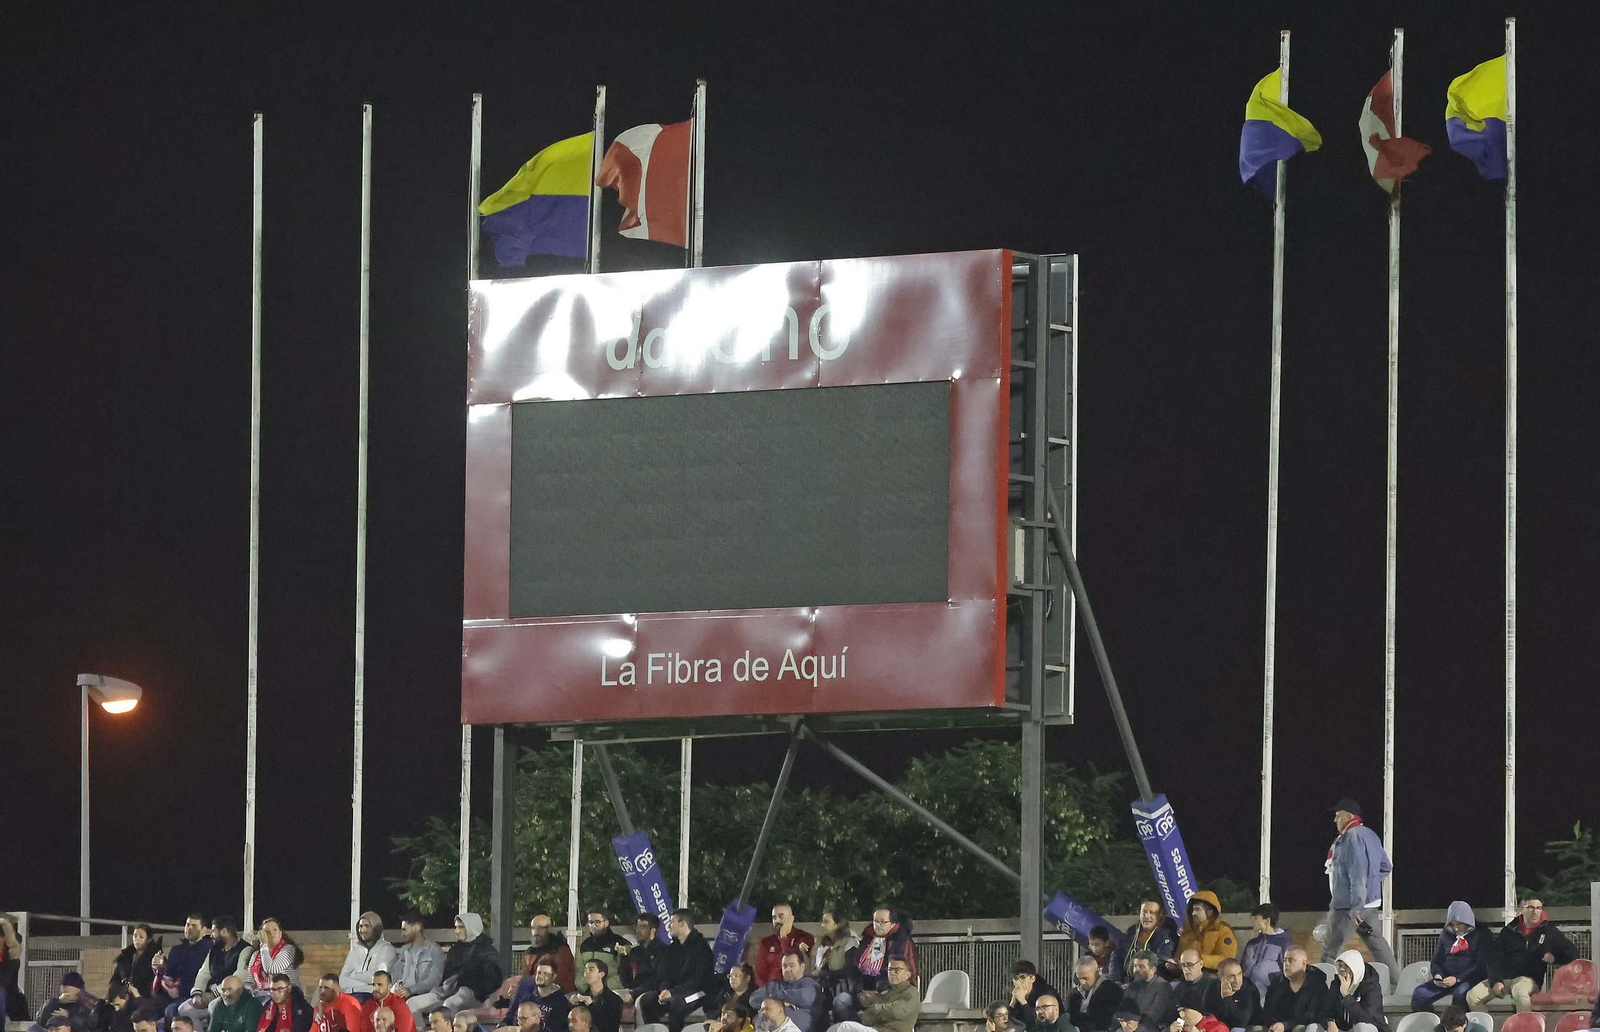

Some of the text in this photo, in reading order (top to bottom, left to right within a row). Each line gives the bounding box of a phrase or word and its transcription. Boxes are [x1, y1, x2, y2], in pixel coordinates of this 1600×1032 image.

[601, 646, 849, 688] La Fibra de Aquí
